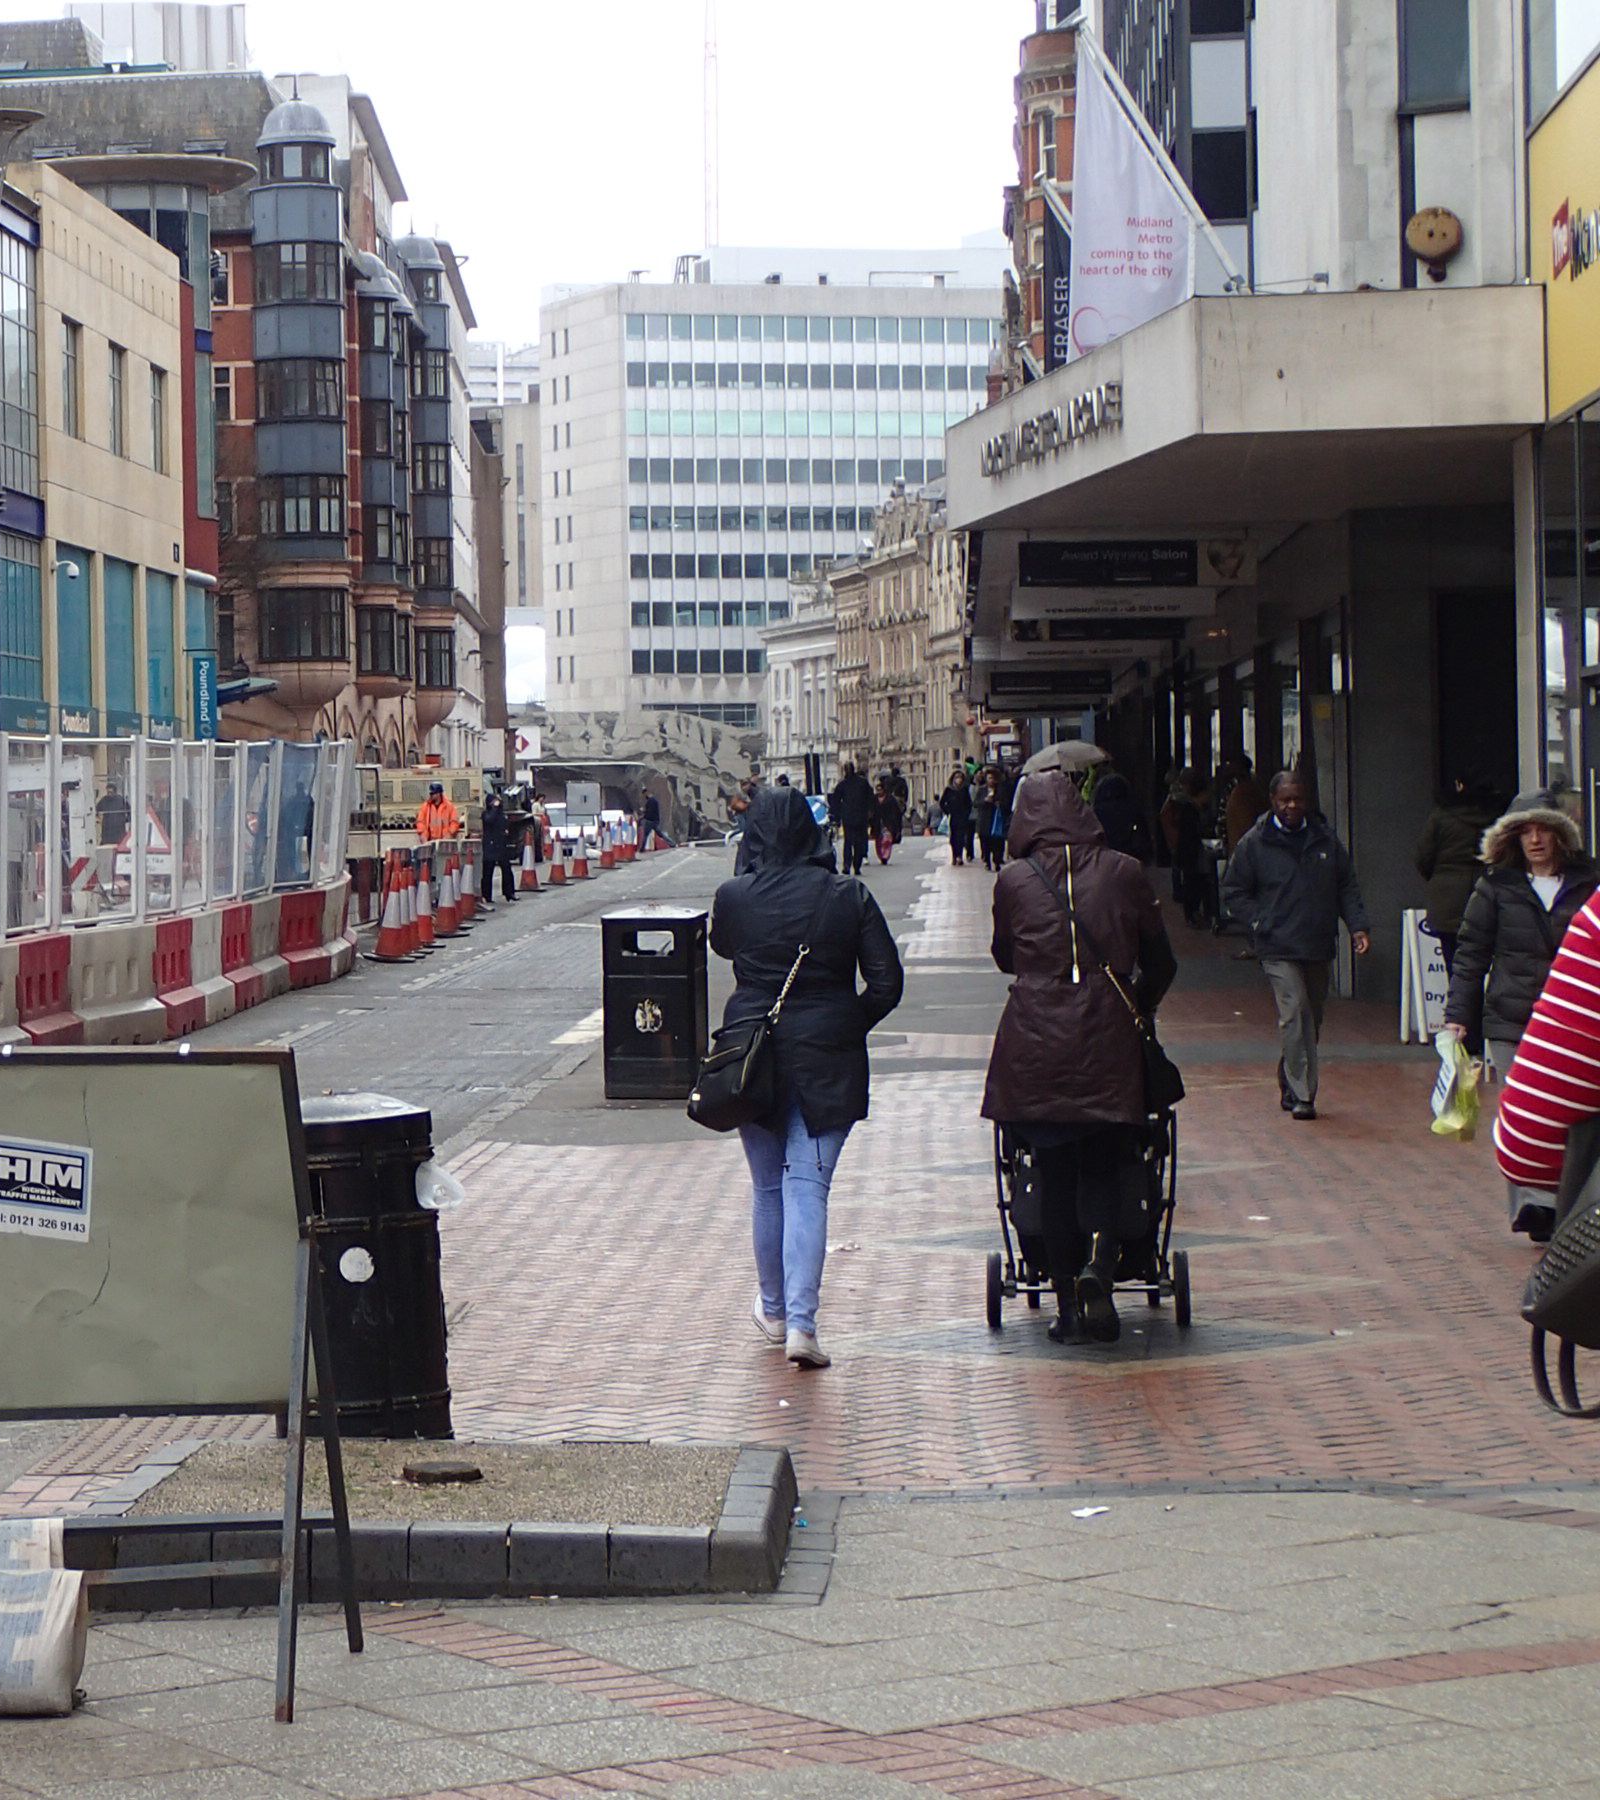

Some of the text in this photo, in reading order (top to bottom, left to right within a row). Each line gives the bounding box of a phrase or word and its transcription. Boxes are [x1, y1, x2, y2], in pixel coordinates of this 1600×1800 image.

[1126, 216, 1173, 228] Midland
[1137, 233, 1173, 244] Metro
[1090, 249, 1173, 261] coming to the
[1079, 265, 1173, 279] heart of the city
[1053, 275, 1069, 359] FRASER
[1061, 549, 1099, 561] Award
[1152, 548, 1188, 560] Salon
[199, 660, 210, 720] Poundland
[1425, 991, 1446, 1004] Dry
[21, 1185, 56, 1197] HIGHWAY
[29, 1193, 81, 1207] MANAGEMENT
[9, 1213, 35, 1227] 0121
[38, 1217, 58, 1230] 326
[60, 1220, 87, 1234] 9143
